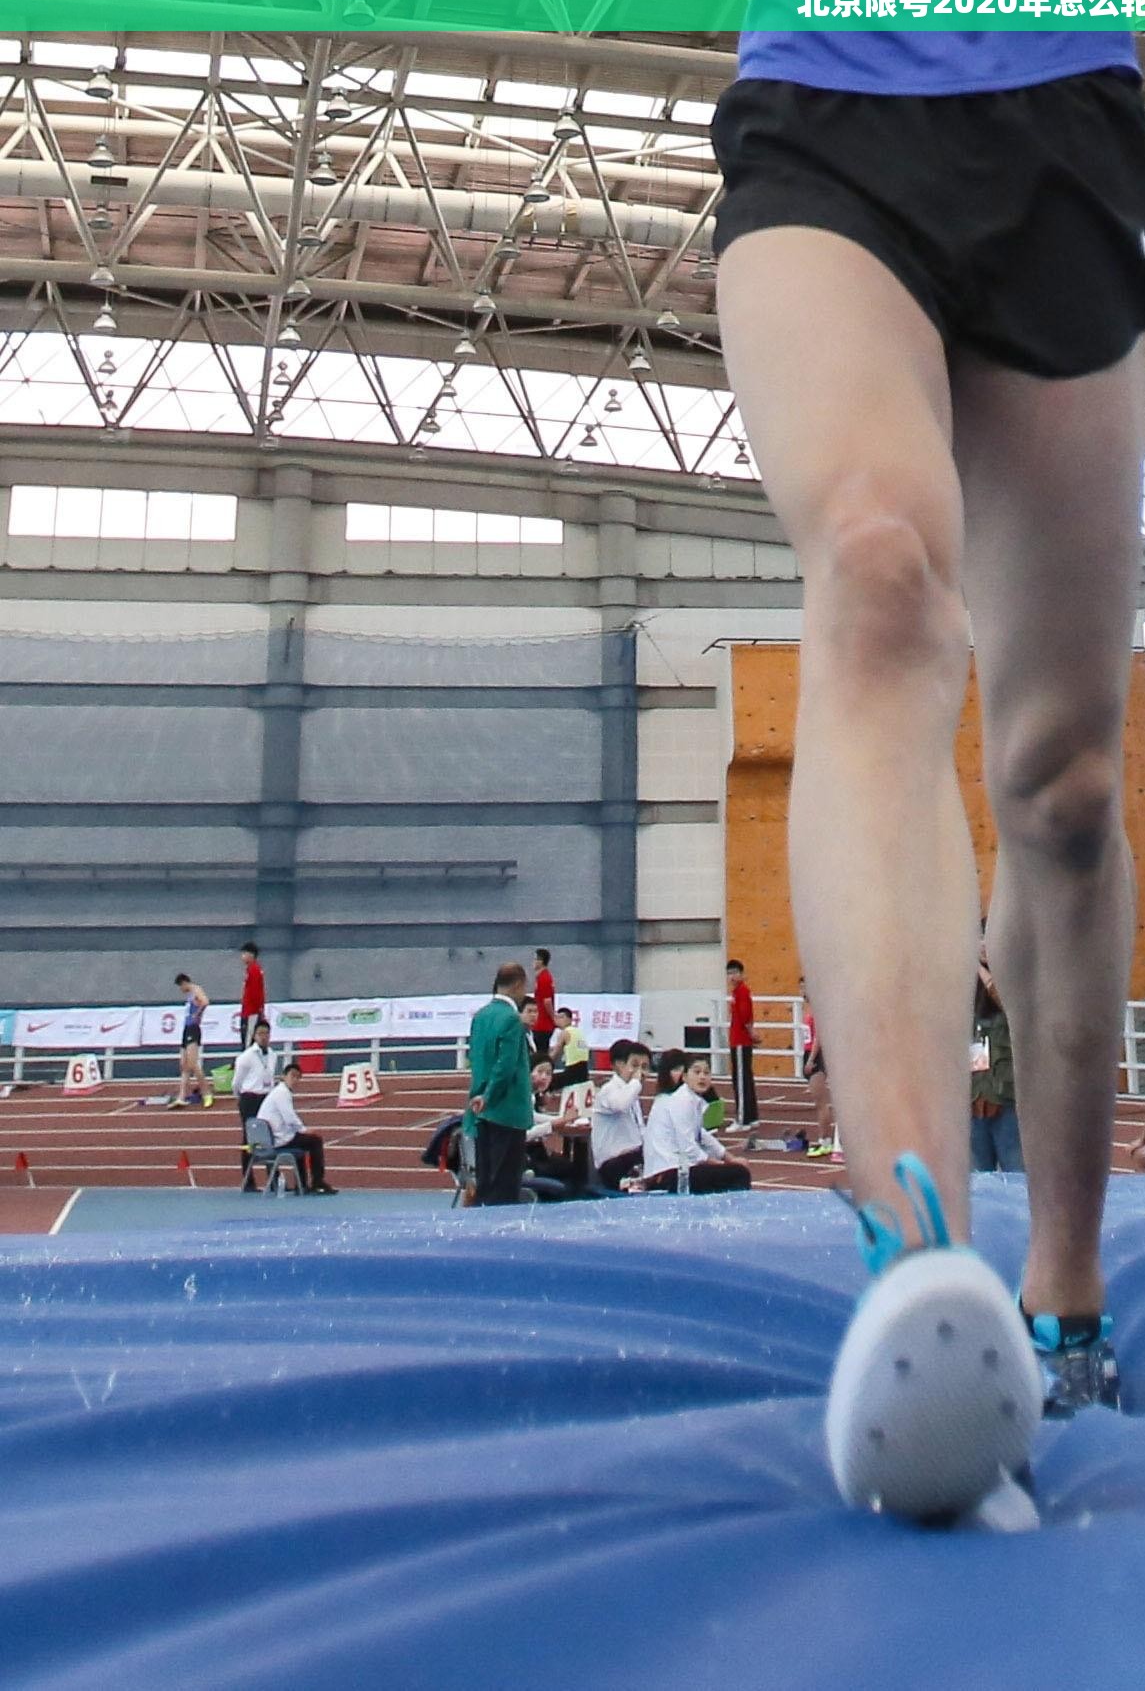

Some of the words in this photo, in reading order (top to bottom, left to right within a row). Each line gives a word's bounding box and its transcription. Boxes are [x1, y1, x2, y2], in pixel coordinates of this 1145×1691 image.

[72, 1063, 84, 1083] 6
[347, 1073, 358, 1093] 5
[364, 1069, 374, 1090] 5
